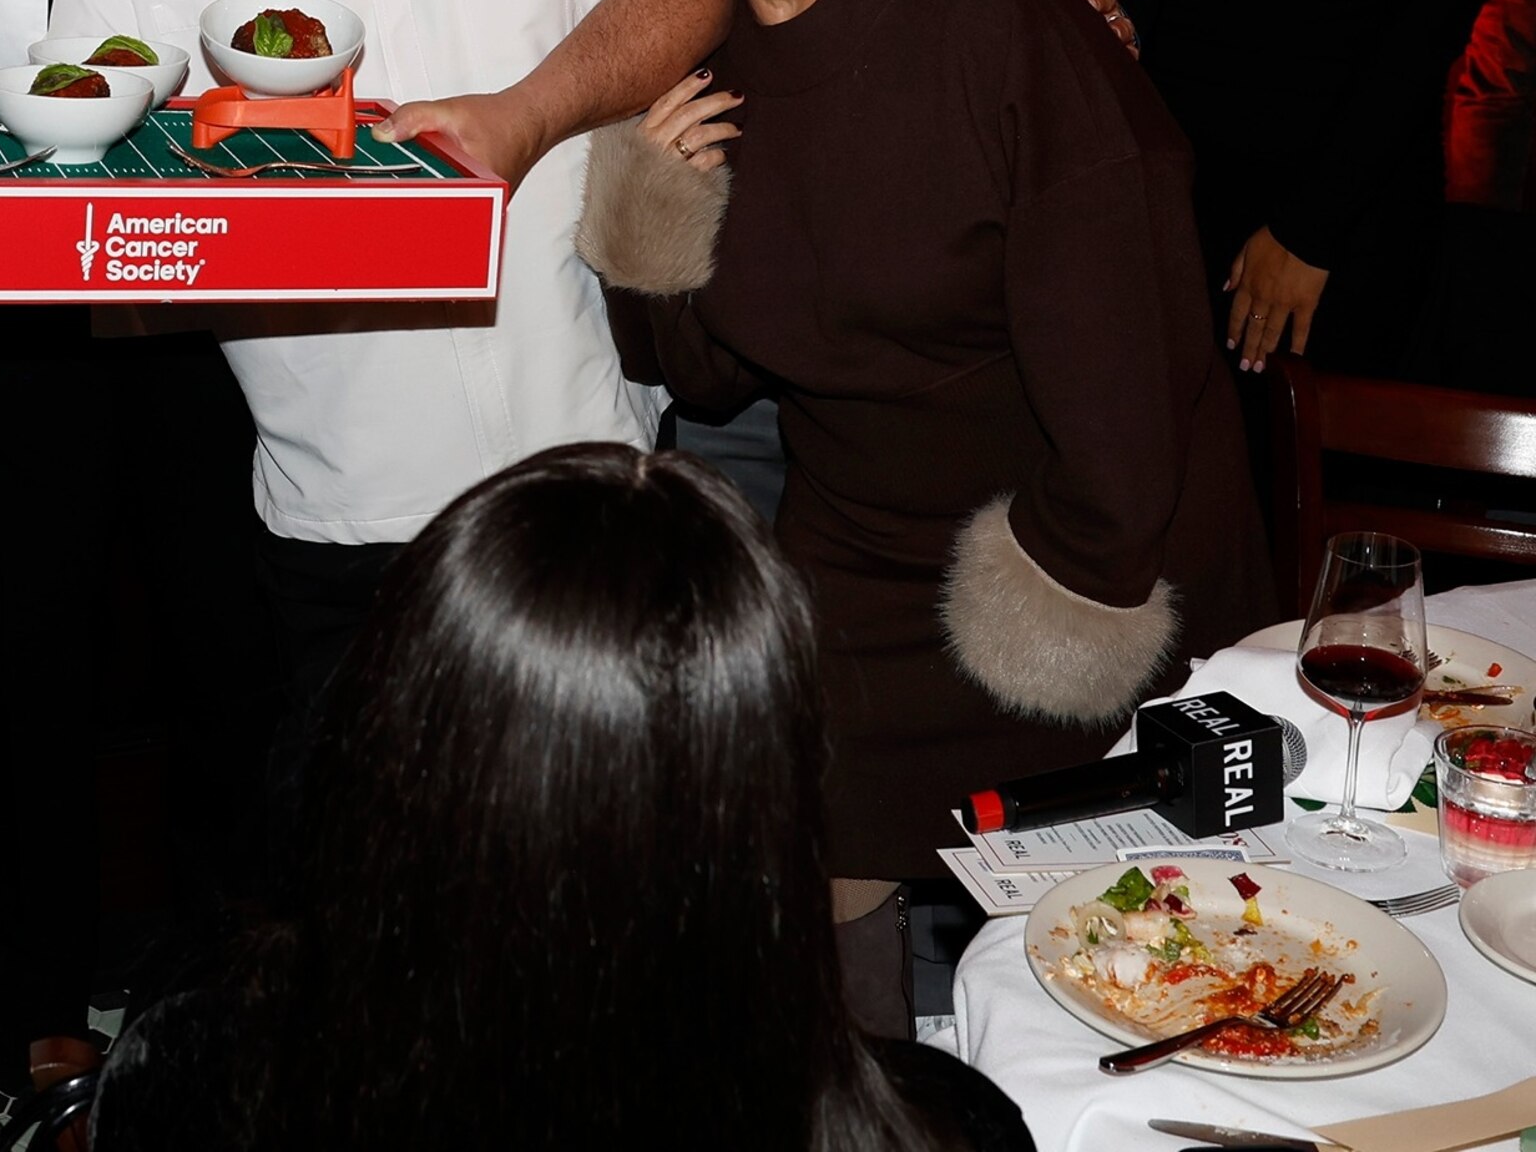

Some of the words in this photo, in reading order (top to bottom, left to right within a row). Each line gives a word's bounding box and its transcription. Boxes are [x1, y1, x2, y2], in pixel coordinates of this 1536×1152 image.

[106, 212, 228, 235] American
[105, 236, 199, 258] Cancer
[105, 259, 202, 286] Society
[1172, 698, 1240, 736] REAL
[1223, 739, 1254, 827] REAL
[1005, 839, 1031, 860] REAL
[994, 878, 1023, 899] REAL
